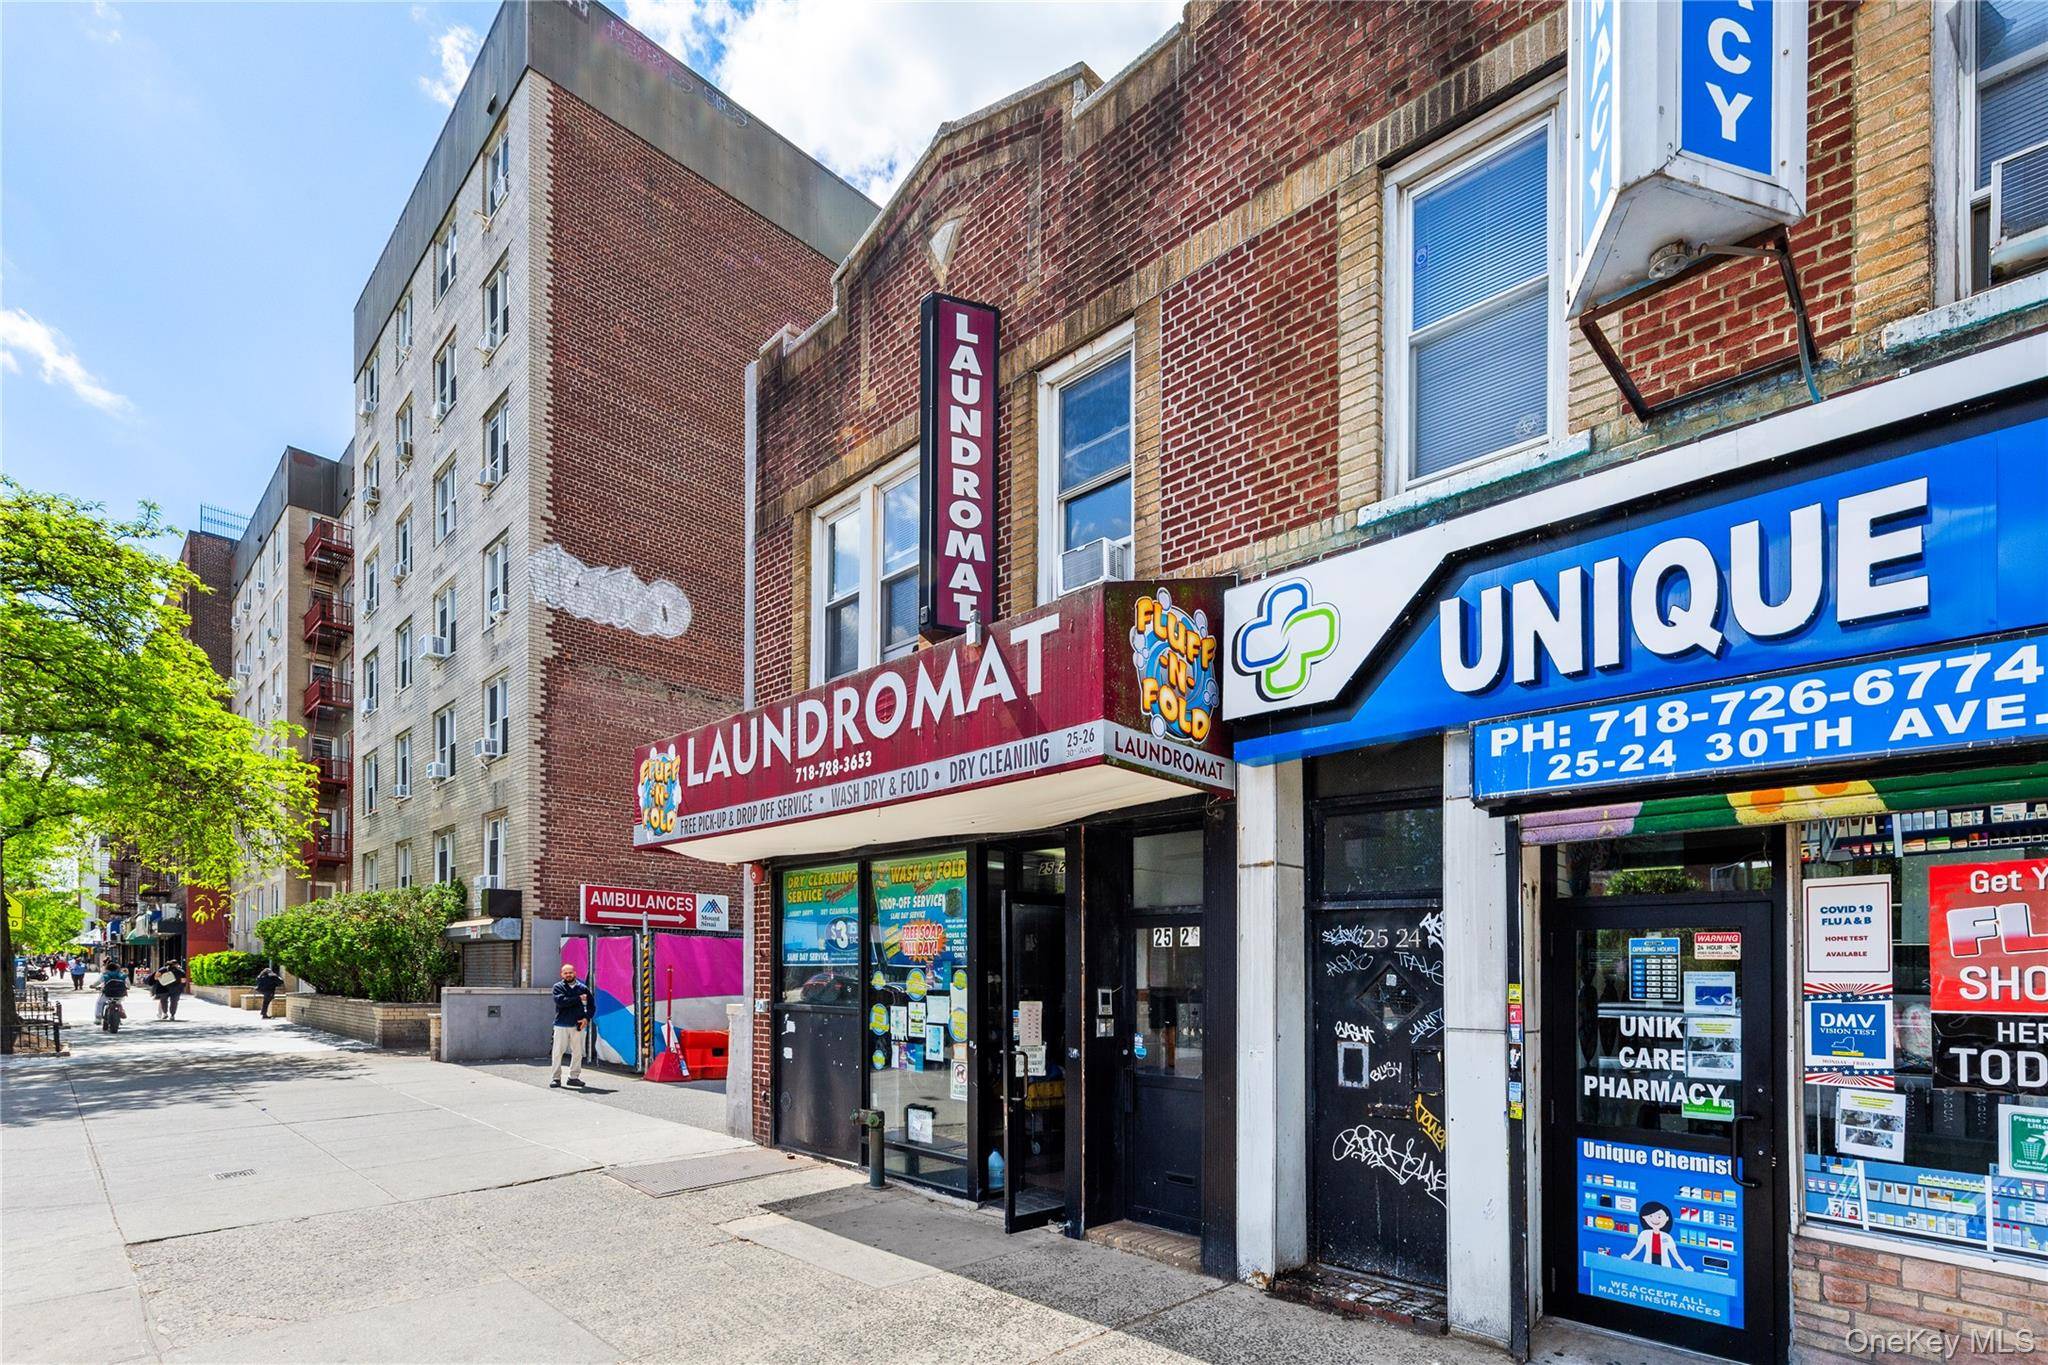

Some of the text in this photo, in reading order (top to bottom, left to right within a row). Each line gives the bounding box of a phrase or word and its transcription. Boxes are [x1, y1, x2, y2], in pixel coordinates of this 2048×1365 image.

[1705, 0, 1754, 143] CY
[944, 312, 987, 622] LAUNDROMAT
[1439, 476, 1930, 695] UNIQUE
[1136, 597, 1217, 670] FLUFF
[687, 613, 1060, 788] LAUNDROMAT
[1142, 677, 1211, 741] FOLD
[1490, 644, 2045, 758] PH: 718-726-6774
[1066, 727, 1095, 748] 25-26
[1547, 693, 2048, 781] 25-24 30TH AVE.
[796, 751, 873, 784] 718-728-3653
[1114, 730, 1226, 781] LAUNDROMAT
[639, 754, 682, 785] FLUFF
[680, 738, 1050, 836] FREE PICK-UP & DROP OFF SERVICE WASH DRY & FOLD DRY CLEANING
[643, 808, 678, 834] FOLD
[787, 875, 805, 889] DRY
[808, 870, 858, 887] CLEANING
[889, 865, 921, 884] WASH
[923, 862, 933, 880] &
[936, 858, 967, 880] FOLD
[1970, 869, 2023, 894] Get
[590, 890, 694, 912] AMBULANCES
[787, 889, 823, 904] SERVICE
[879, 896, 912, 910] DROP-OFF
[1820, 905, 1873, 914] COVID 19
[701, 914, 720, 922] Mount
[1821, 917, 1872, 925] FLU A & B
[902, 925, 919, 940] FREE
[920, 923, 943, 939] SOAP
[1154, 928, 1171, 947] 25
[1363, 928, 1389, 949] 25
[1395, 928, 1421, 949] 24
[1619, 1015, 1684, 1039] UNIK
[1820, 1012, 1876, 1028] DMV
[1820, 1027, 1877, 1036] VISION TEST
[1618, 1046, 1686, 1072] CARE
[1949, 1047, 2048, 1088] TOD
[1583, 1074, 1726, 1108] PHARMACY
[2013, 1115, 2041, 1124] Please
[1583, 1141, 1733, 1176] Unique Chemist
[1598, 1285, 1721, 1317] MAJOR INSURANCES
[1611, 1280, 1707, 1307] WE ACCEPT ALL
